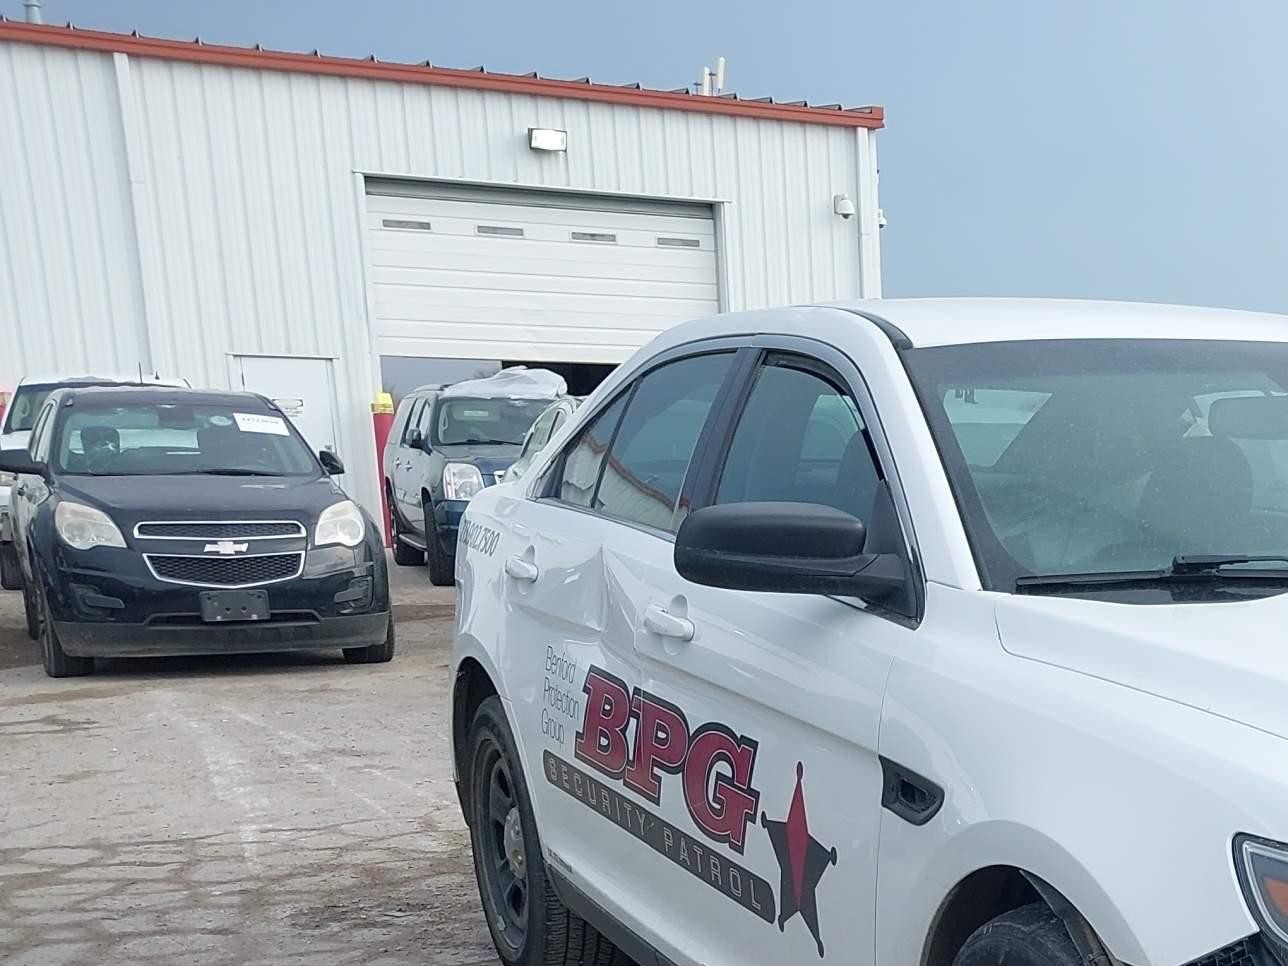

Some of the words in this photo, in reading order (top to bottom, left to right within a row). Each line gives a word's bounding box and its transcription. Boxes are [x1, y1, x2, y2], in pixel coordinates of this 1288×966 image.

[541, 707, 566, 752] Group
[543, 676, 580, 721] Protection
[574, 663, 761, 856] BPG
[548, 757, 647, 836] SECURITY
[663, 826, 762, 911] PATROL
